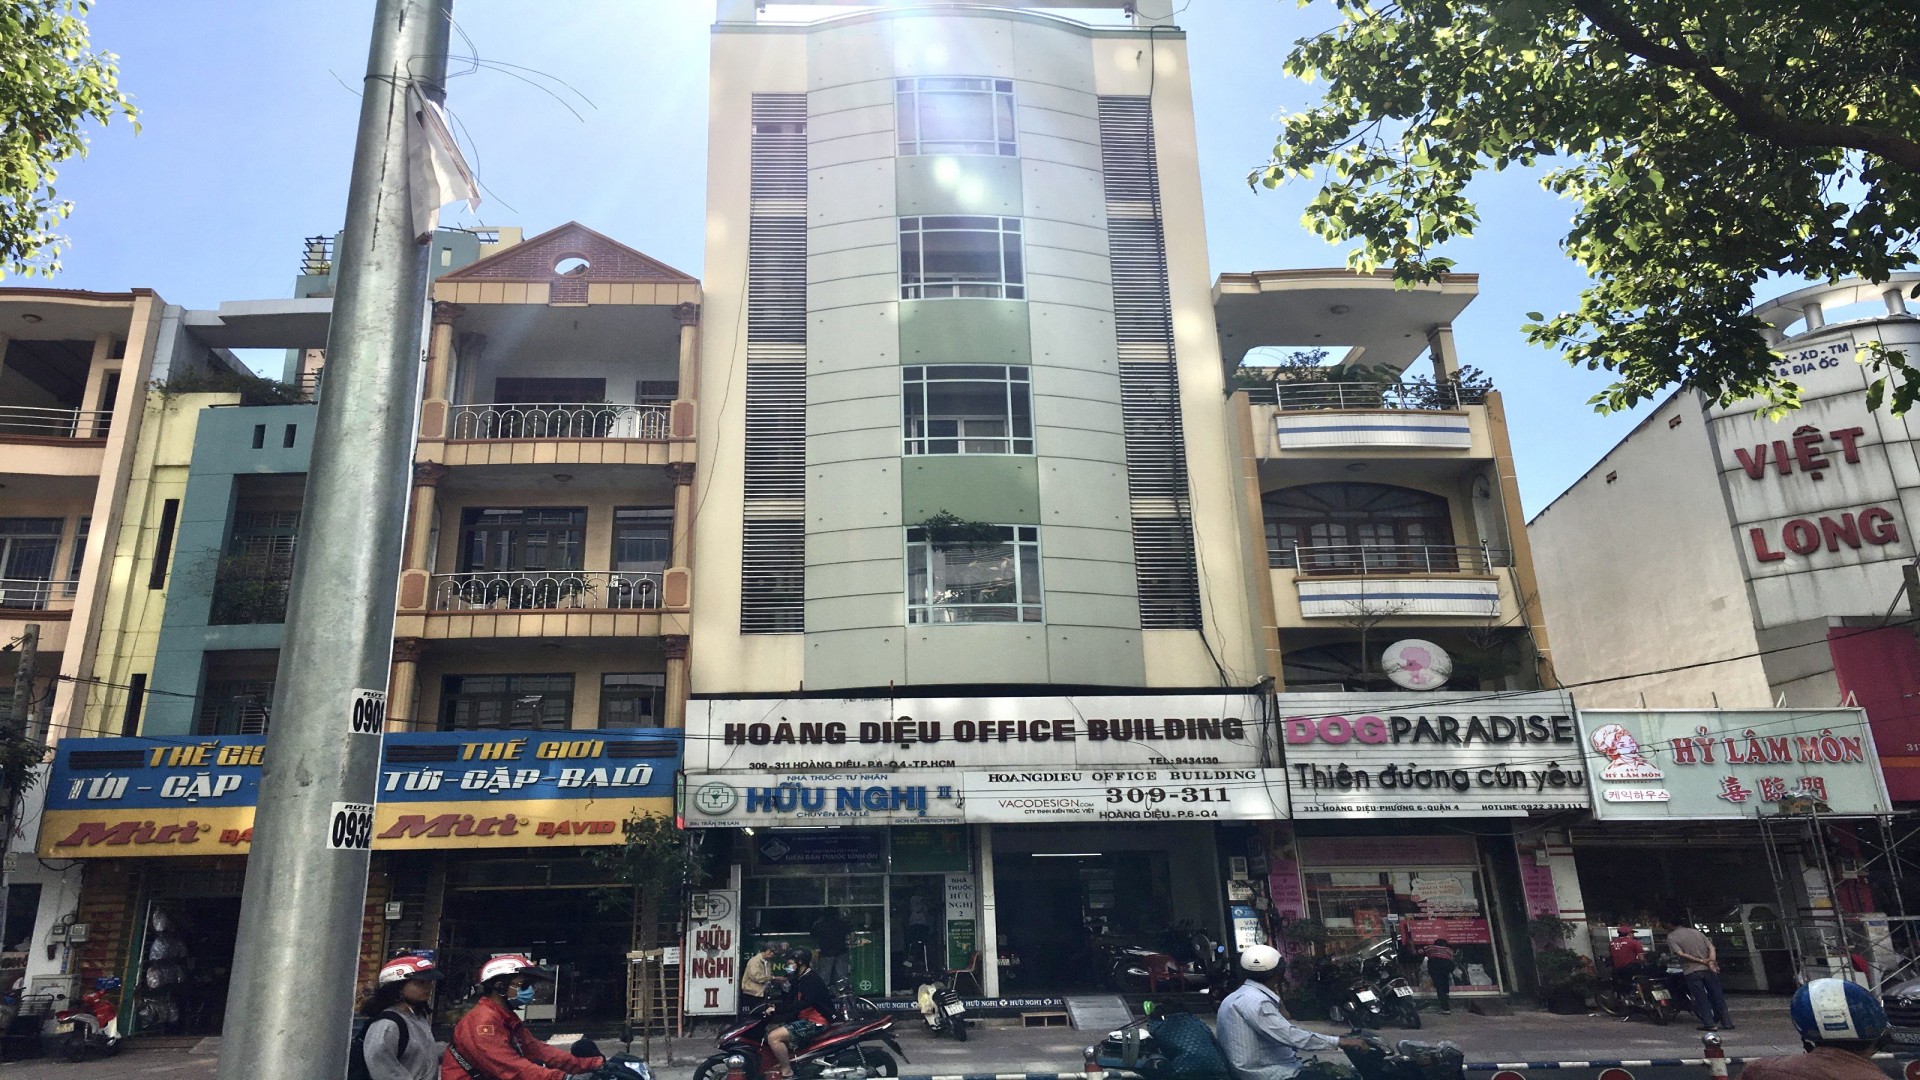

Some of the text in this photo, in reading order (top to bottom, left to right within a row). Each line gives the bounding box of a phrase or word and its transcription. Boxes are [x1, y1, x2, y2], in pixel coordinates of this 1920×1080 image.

[1800, 349, 1818, 361] XD
[1828, 342, 1849, 354] TM
[1819, 356, 1839, 369] ỐC
[1734, 424, 1864, 481] VIỆT
[1749, 507, 1900, 563] LONG
[724, 715, 1244, 749] HOÀNG DIỆU OFFICE BUILDING
[1722, 729, 1792, 764] LÂM
[1796, 728, 1865, 764] MÔN
[149, 739, 220, 767] THẾ
[462, 737, 528, 760] THẾ
[988, 770, 1257, 783] HOANGDIEU OFFICE BUILDING
[1294, 763, 1370, 789] Thiên
[1530, 761, 1584, 792] yêu
[747, 782, 827, 813] HỮU
[836, 785, 928, 816] NGHỊ
[1099, 808, 1142, 819] HOÀNG
[1143, 808, 1170, 820] DIỆU
[692, 957, 733, 984] NGHỊ
